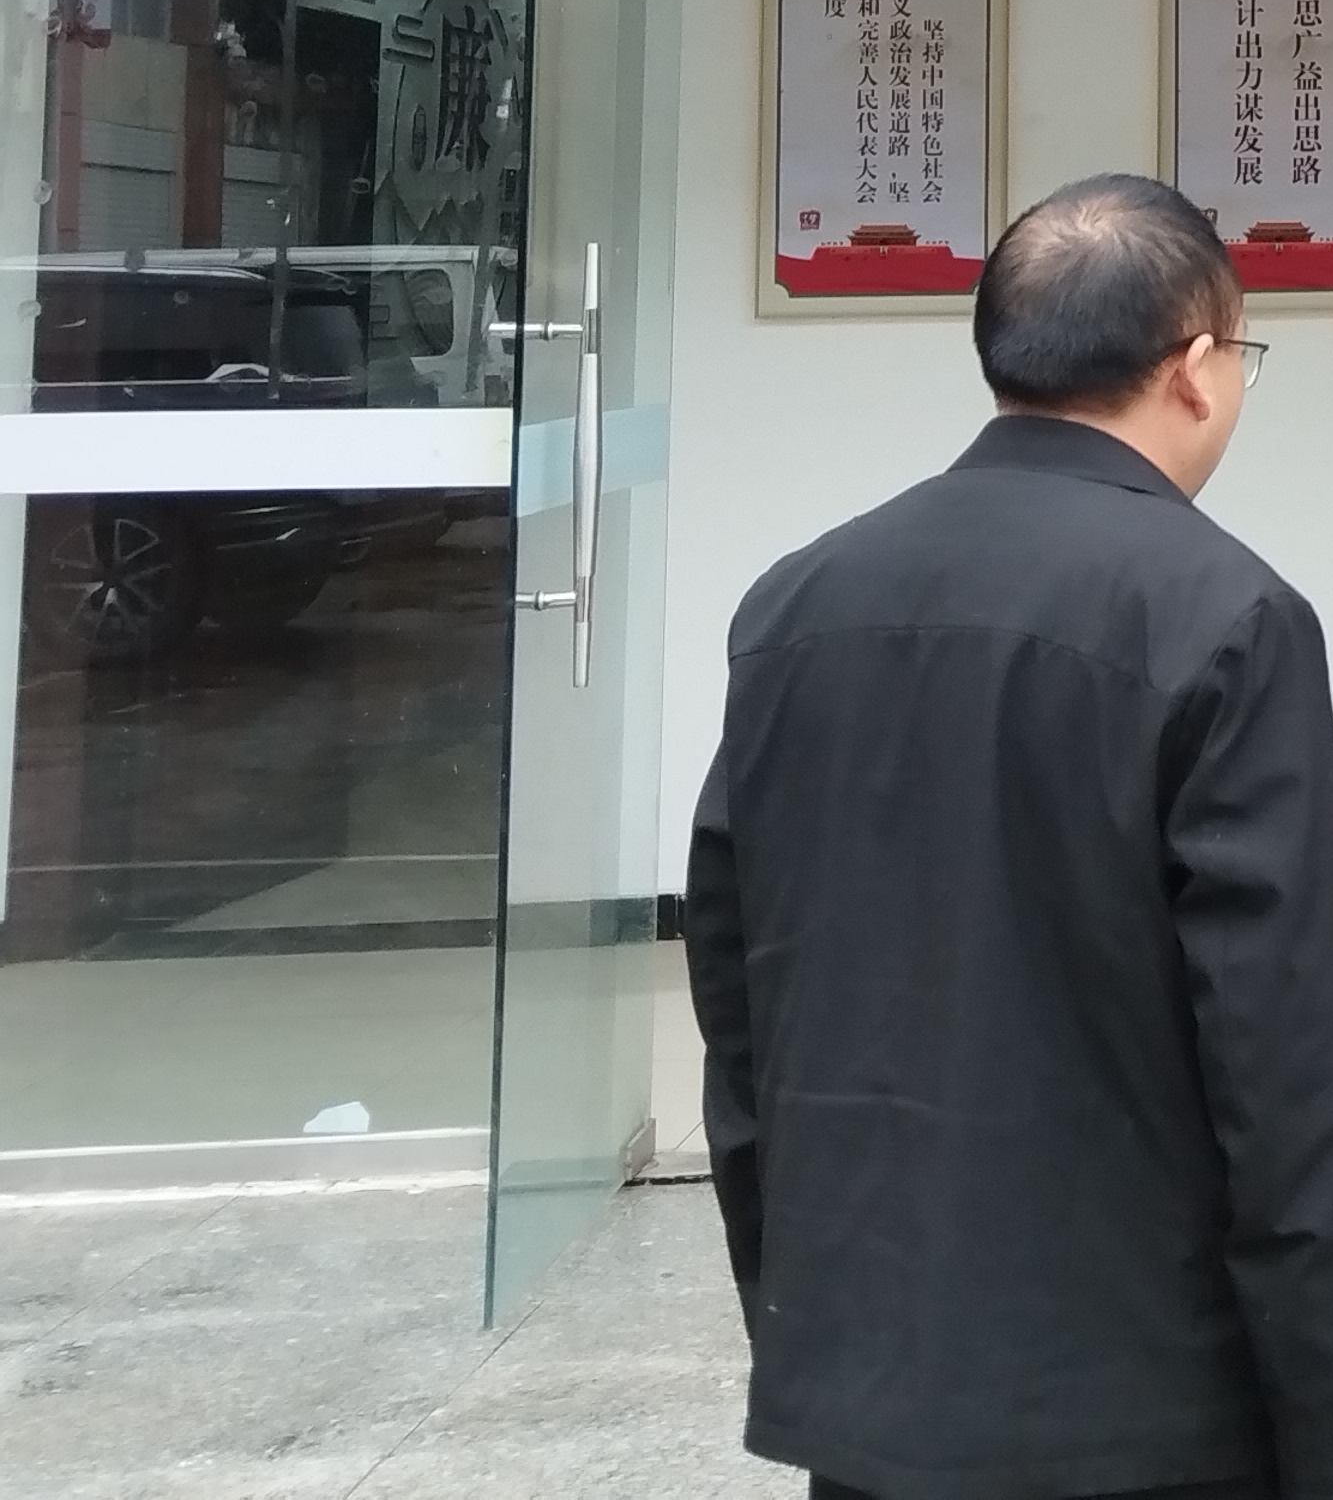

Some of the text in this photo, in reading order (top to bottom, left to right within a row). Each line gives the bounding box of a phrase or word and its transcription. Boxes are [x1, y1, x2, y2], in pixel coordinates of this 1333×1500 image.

[920, 19, 945, 204] 坚持中国特色社会
